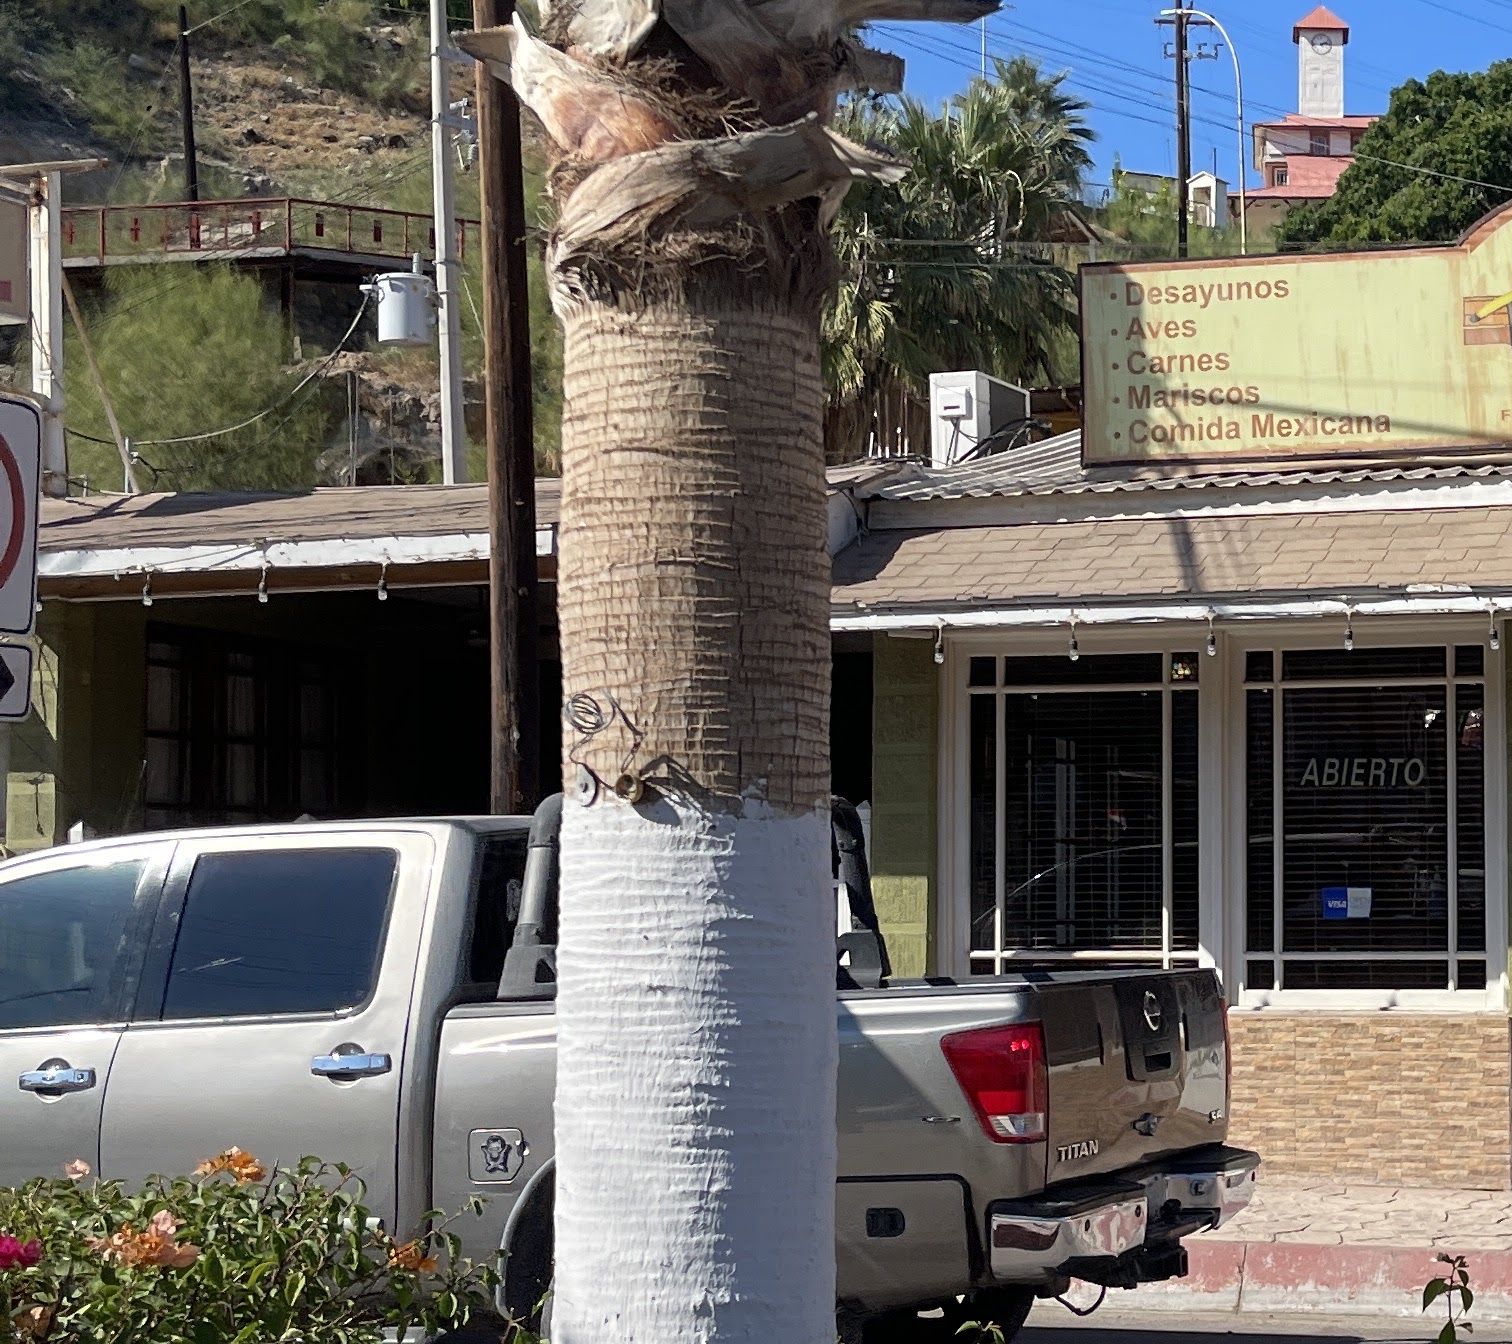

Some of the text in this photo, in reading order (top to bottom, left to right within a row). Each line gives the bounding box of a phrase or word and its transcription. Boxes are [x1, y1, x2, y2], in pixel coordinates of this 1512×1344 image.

[1125, 278, 1290, 309] Desayunos
[1126, 316, 1197, 341] Aves
[1127, 351, 1231, 375] Carnes
[1128, 383, 1261, 410] Mariscos
[1129, 411, 1392, 445] Comida Mexicana
[1300, 757, 1425, 787] ABIERTO
[1327, 900, 1347, 909] VISA
[1057, 1139, 1099, 1162] TITAN
